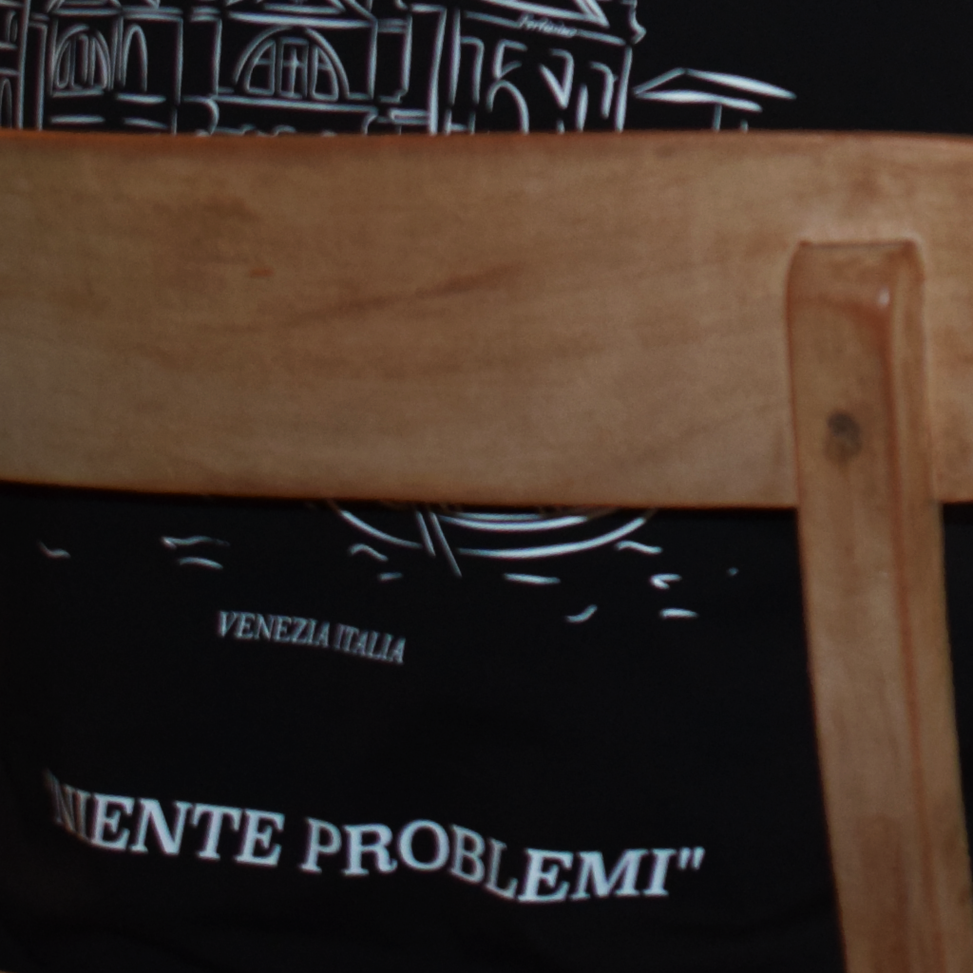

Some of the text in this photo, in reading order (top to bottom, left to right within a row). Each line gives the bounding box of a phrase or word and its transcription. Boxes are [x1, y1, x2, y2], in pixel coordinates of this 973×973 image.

[218, 610, 406, 664] VENEZIA ITALIA
[299, 817, 705, 904] PROBLEMI"
